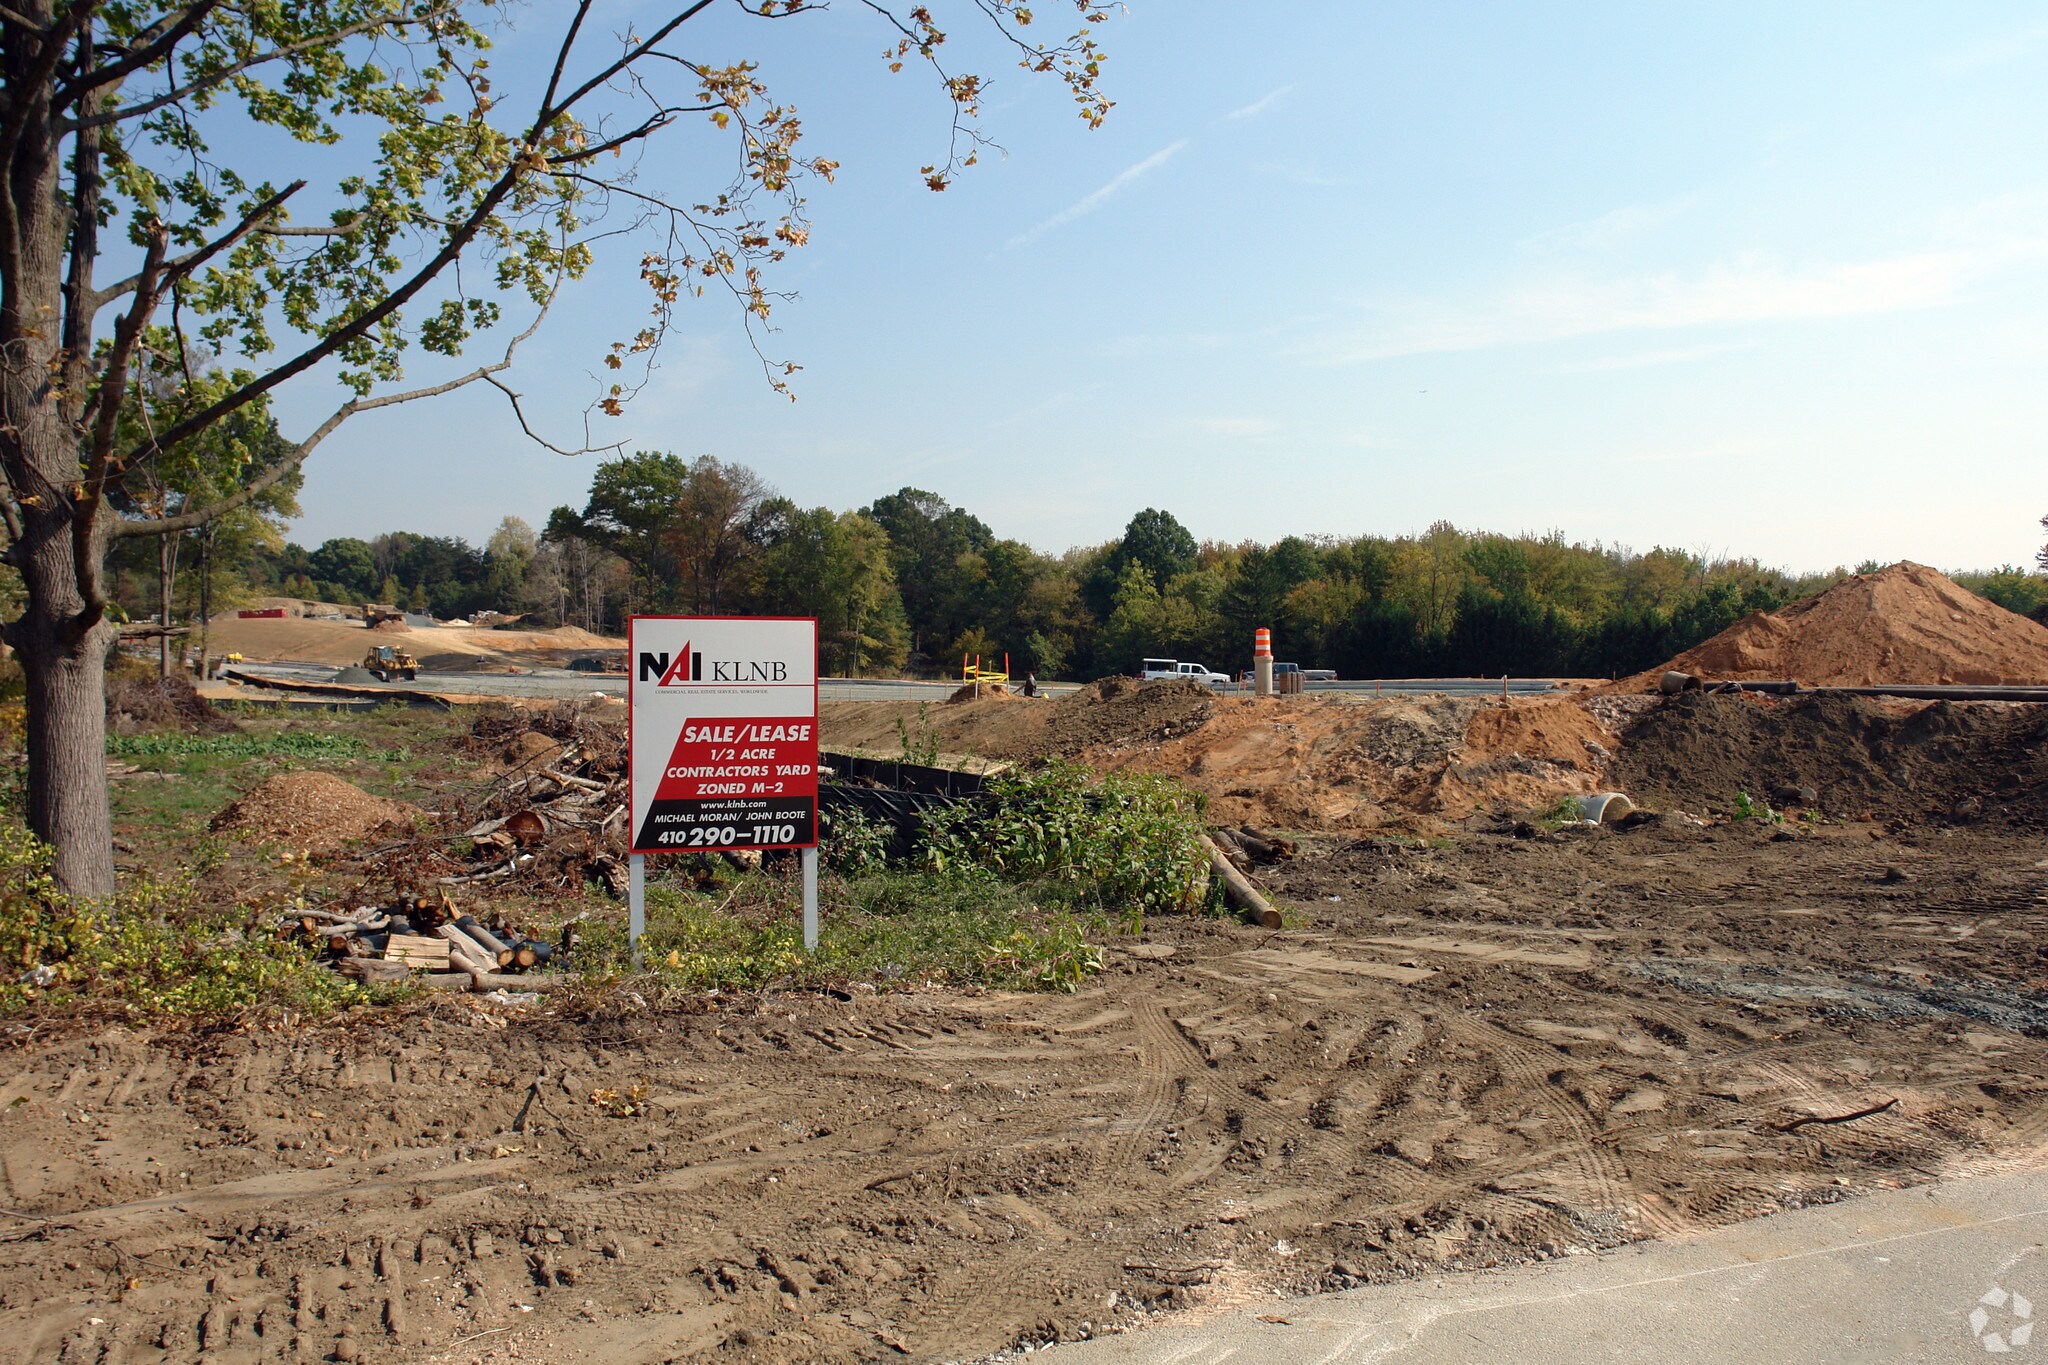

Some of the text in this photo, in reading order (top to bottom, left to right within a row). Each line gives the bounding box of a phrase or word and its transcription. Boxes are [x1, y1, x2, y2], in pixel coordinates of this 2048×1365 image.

[712, 661, 787, 681] KLNB
[683, 724, 811, 744] SALE/LEASE
[710, 748, 776, 761] 1/2 ACRE
[667, 765, 811, 778] CONTRACTORS YARD
[696, 782, 783, 795] ZONED M-2
[700, 800, 767, 809] www.klnb.com
[654, 811, 806, 823] MICHAEL MORAN/ JOHN BOOTE
[658, 824, 795, 846] 410 290-1110
